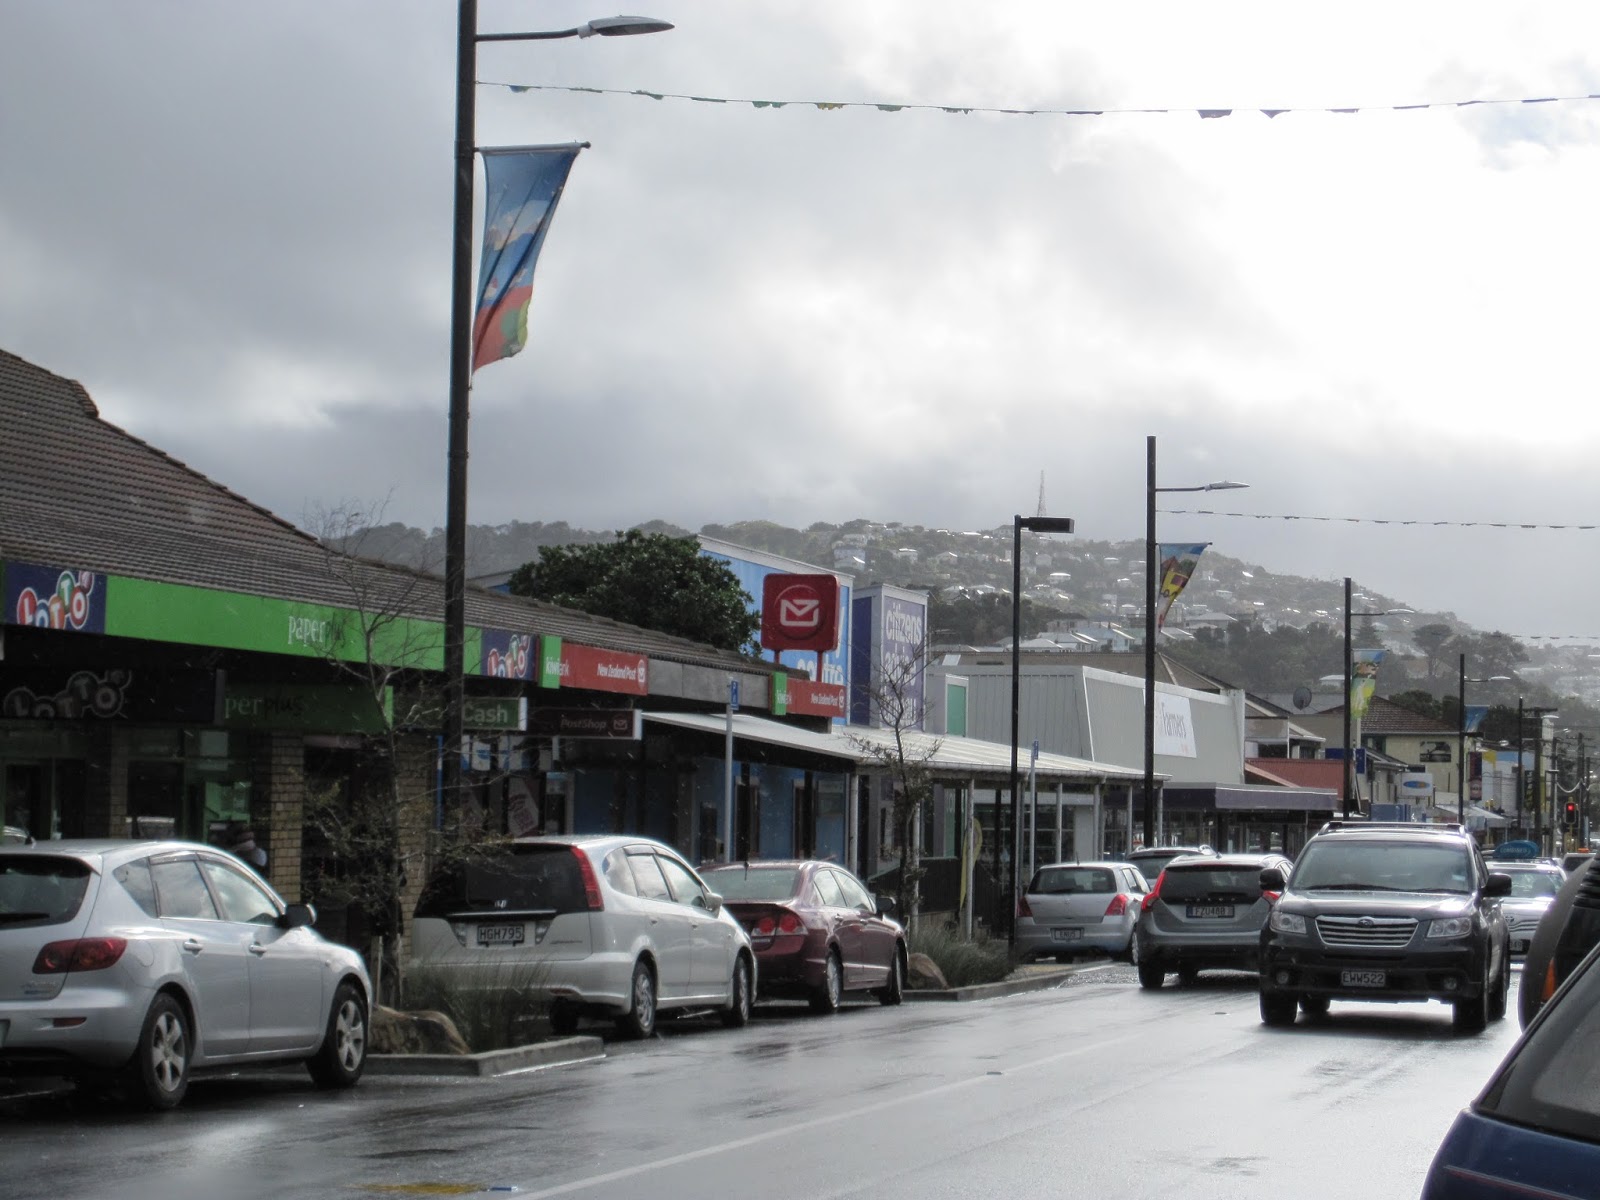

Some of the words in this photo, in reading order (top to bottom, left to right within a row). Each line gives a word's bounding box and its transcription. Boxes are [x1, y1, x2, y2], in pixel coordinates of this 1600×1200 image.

[288, 615, 325, 647] paper
[545, 656, 570, 677] Kiwiank
[597, 663, 608, 677] New
[608, 664, 627, 679] Zealand
[626, 666, 636, 680] Post
[224, 697, 264, 719] per
[479, 927, 522, 940] HGH795
[1343, 973, 1384, 984] EWW522
